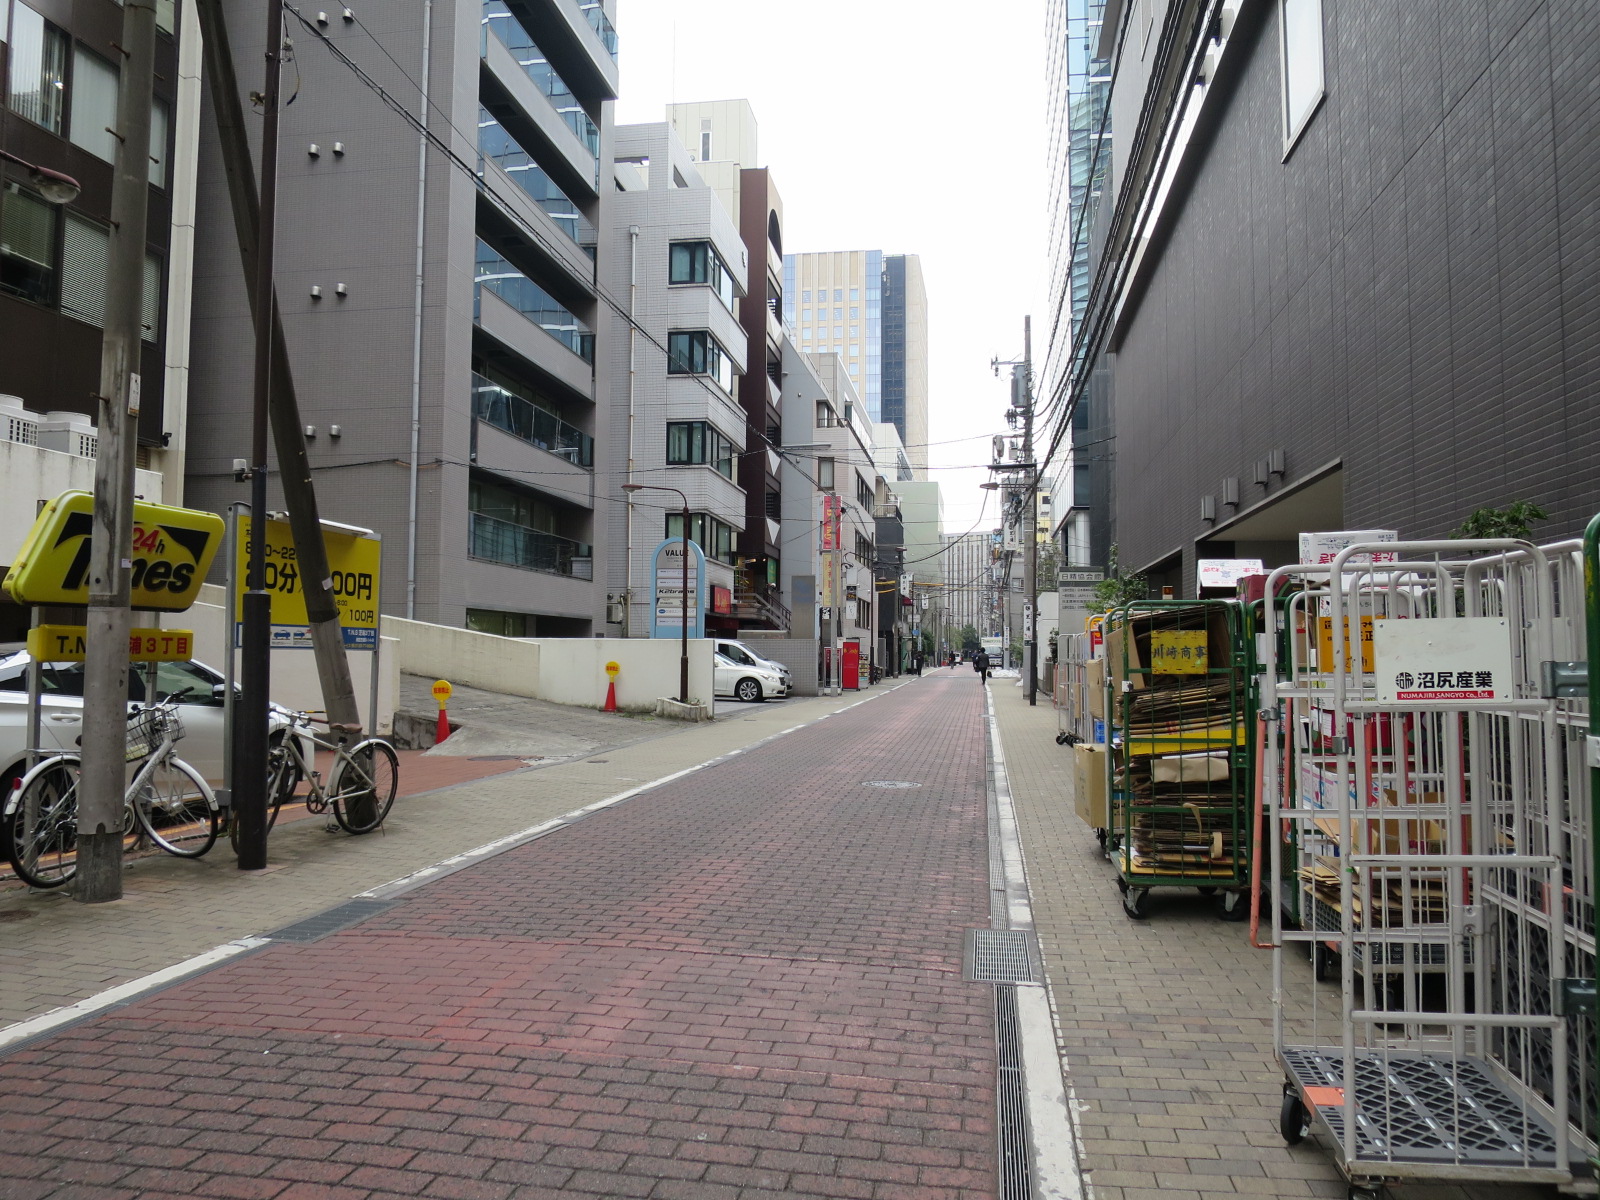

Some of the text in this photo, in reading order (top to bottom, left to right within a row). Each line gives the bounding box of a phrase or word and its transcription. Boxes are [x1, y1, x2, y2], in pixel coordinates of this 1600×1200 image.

[132, 526, 165, 555] 24h
[665, 549, 689, 557] VALU
[331, 570, 372, 600] 00円
[1417, 670, 1493, 689] 沼尻産業
